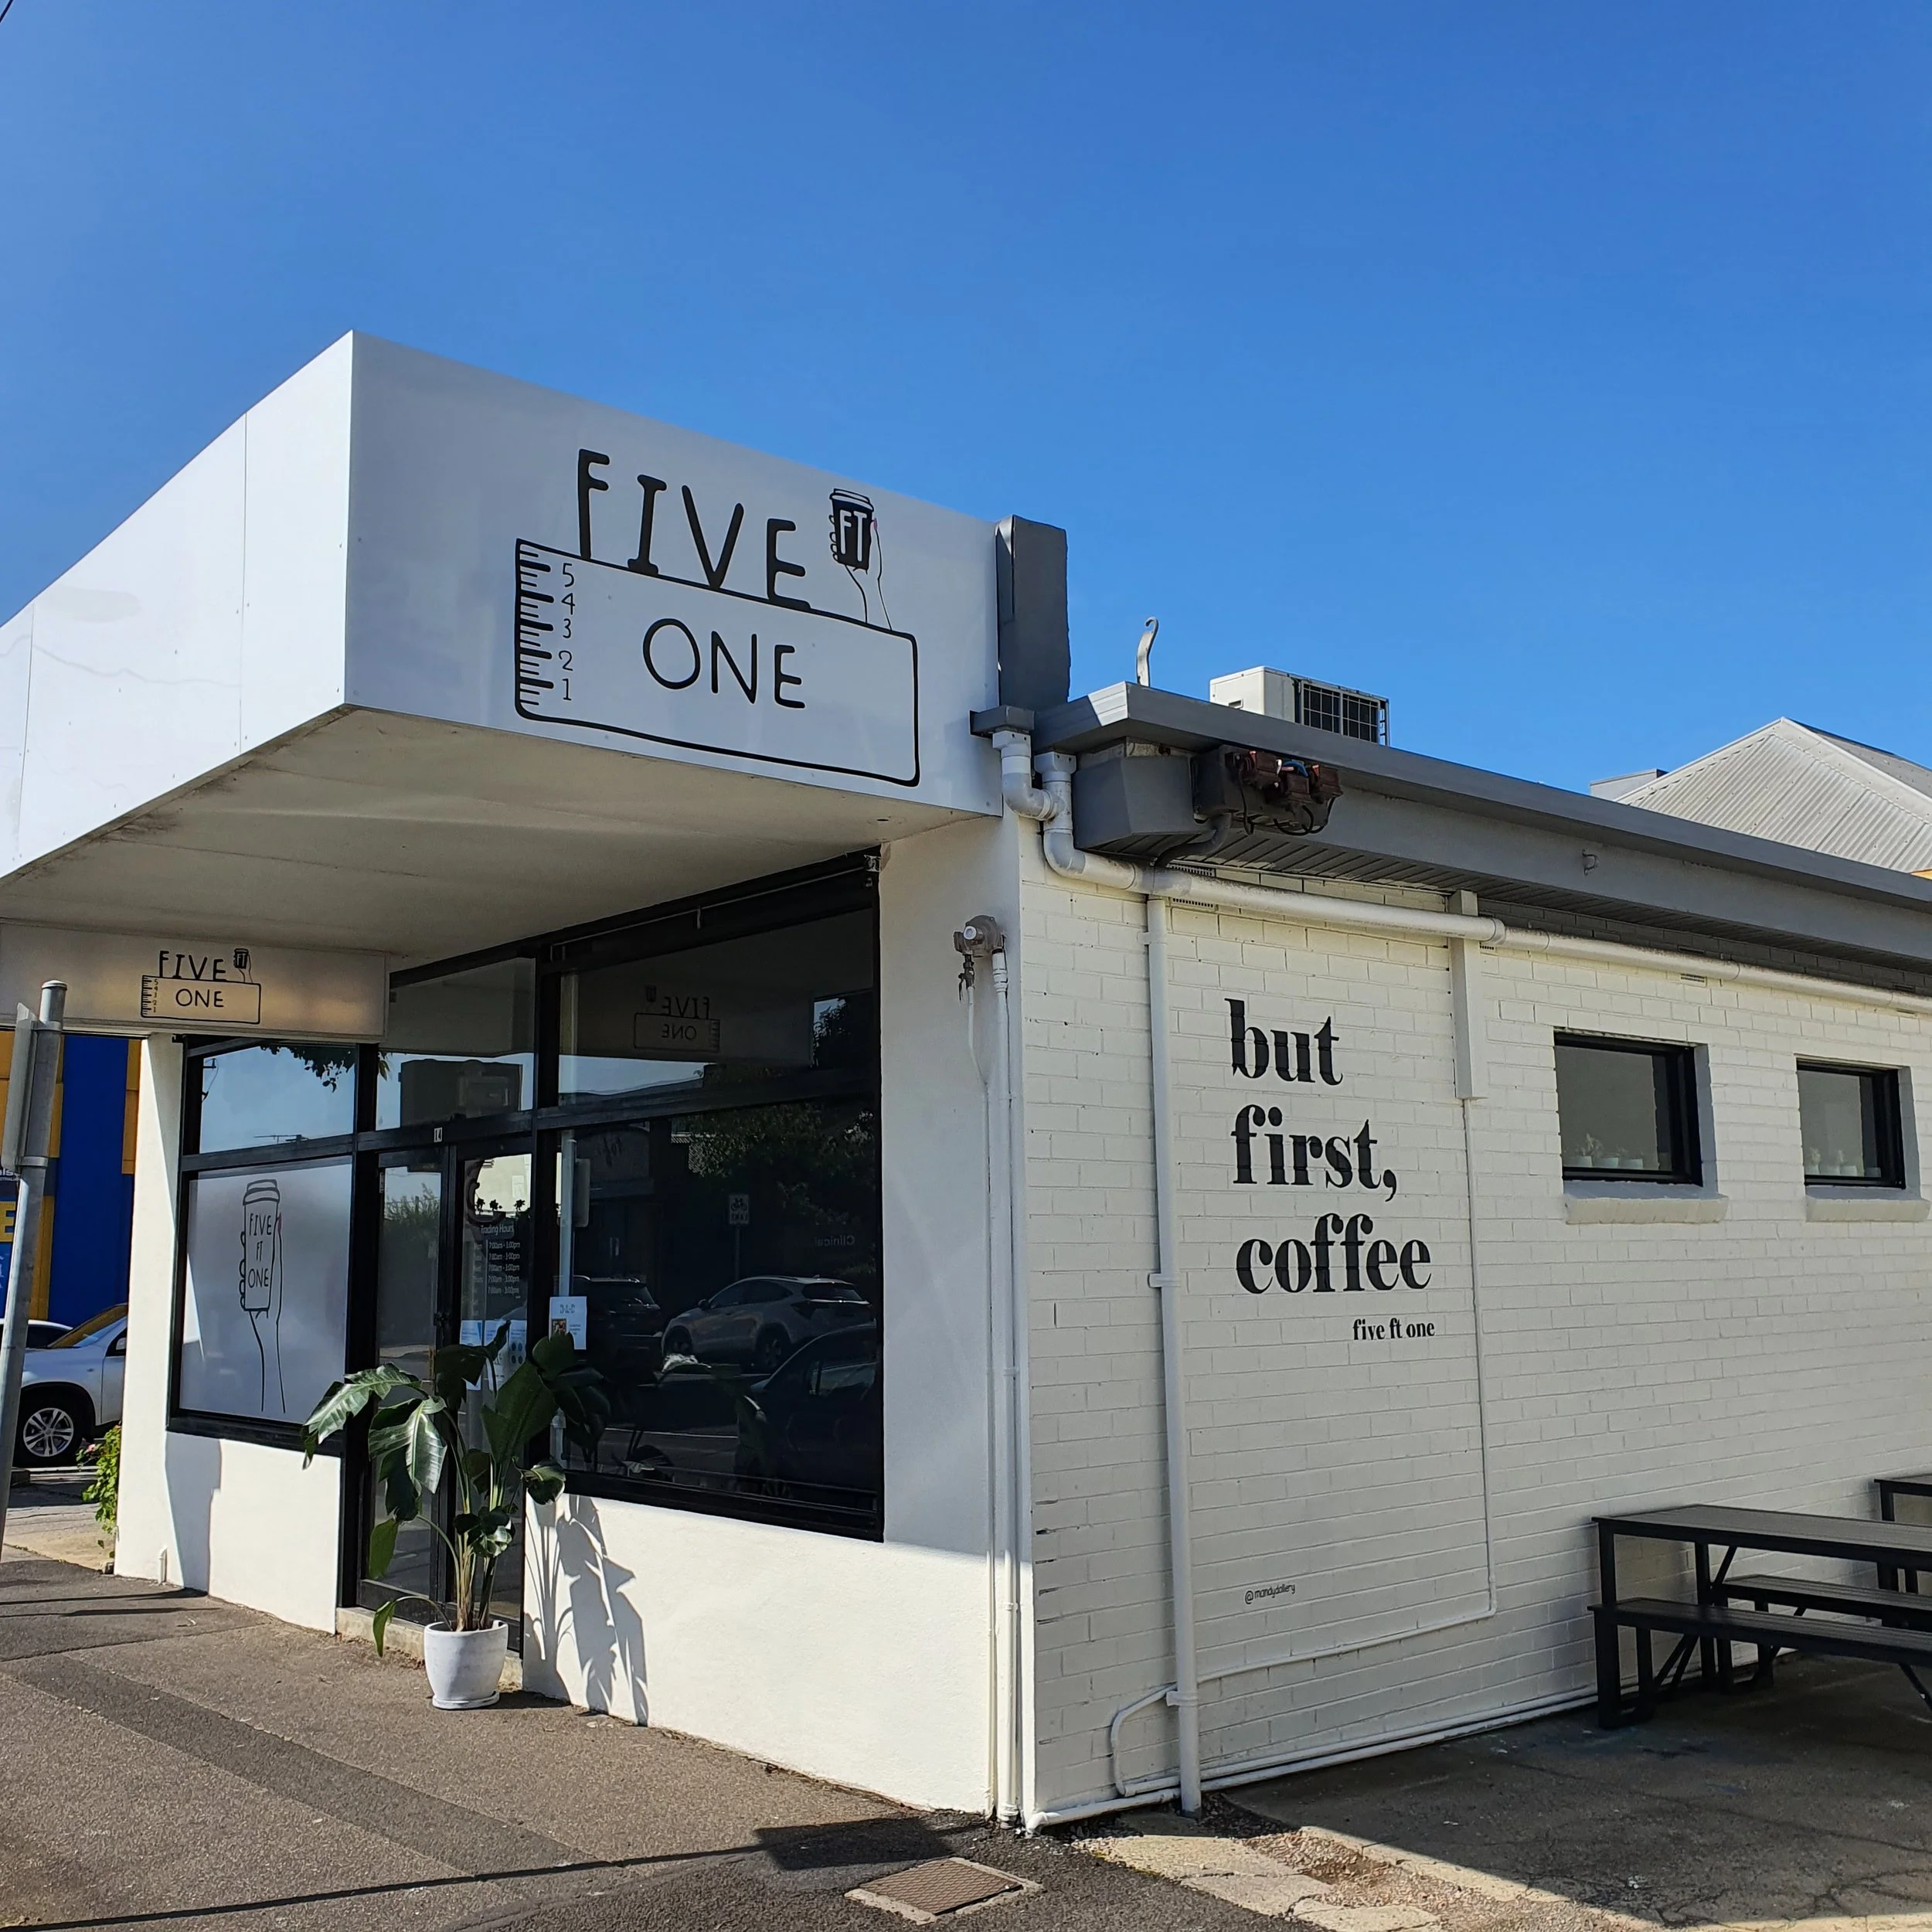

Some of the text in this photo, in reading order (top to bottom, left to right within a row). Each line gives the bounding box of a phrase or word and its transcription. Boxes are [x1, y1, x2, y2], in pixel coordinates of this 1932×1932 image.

[576, 449, 867, 610] FIVE FT
[561, 563, 575, 588] 5
[561, 592, 576, 616] 4
[562, 617, 573, 639] 3
[558, 649, 574, 672] 2
[642, 617, 805, 709] ONE
[562, 678, 573, 701] 1
[159, 950, 247, 982] FIVE FT
[175, 988, 225, 1009] ONE
[1224, 998, 1343, 1086] but
[1231, 1104, 1397, 1202] first,
[249, 1213, 272, 1236] FIVE
[480, 1223, 515, 1236] Trading Hours
[256, 1240, 264, 1261] FT
[1236, 1213, 1432, 1294] coffee
[248, 1268, 269, 1289] ONE
[1352, 1317, 1436, 1341] five ft one
